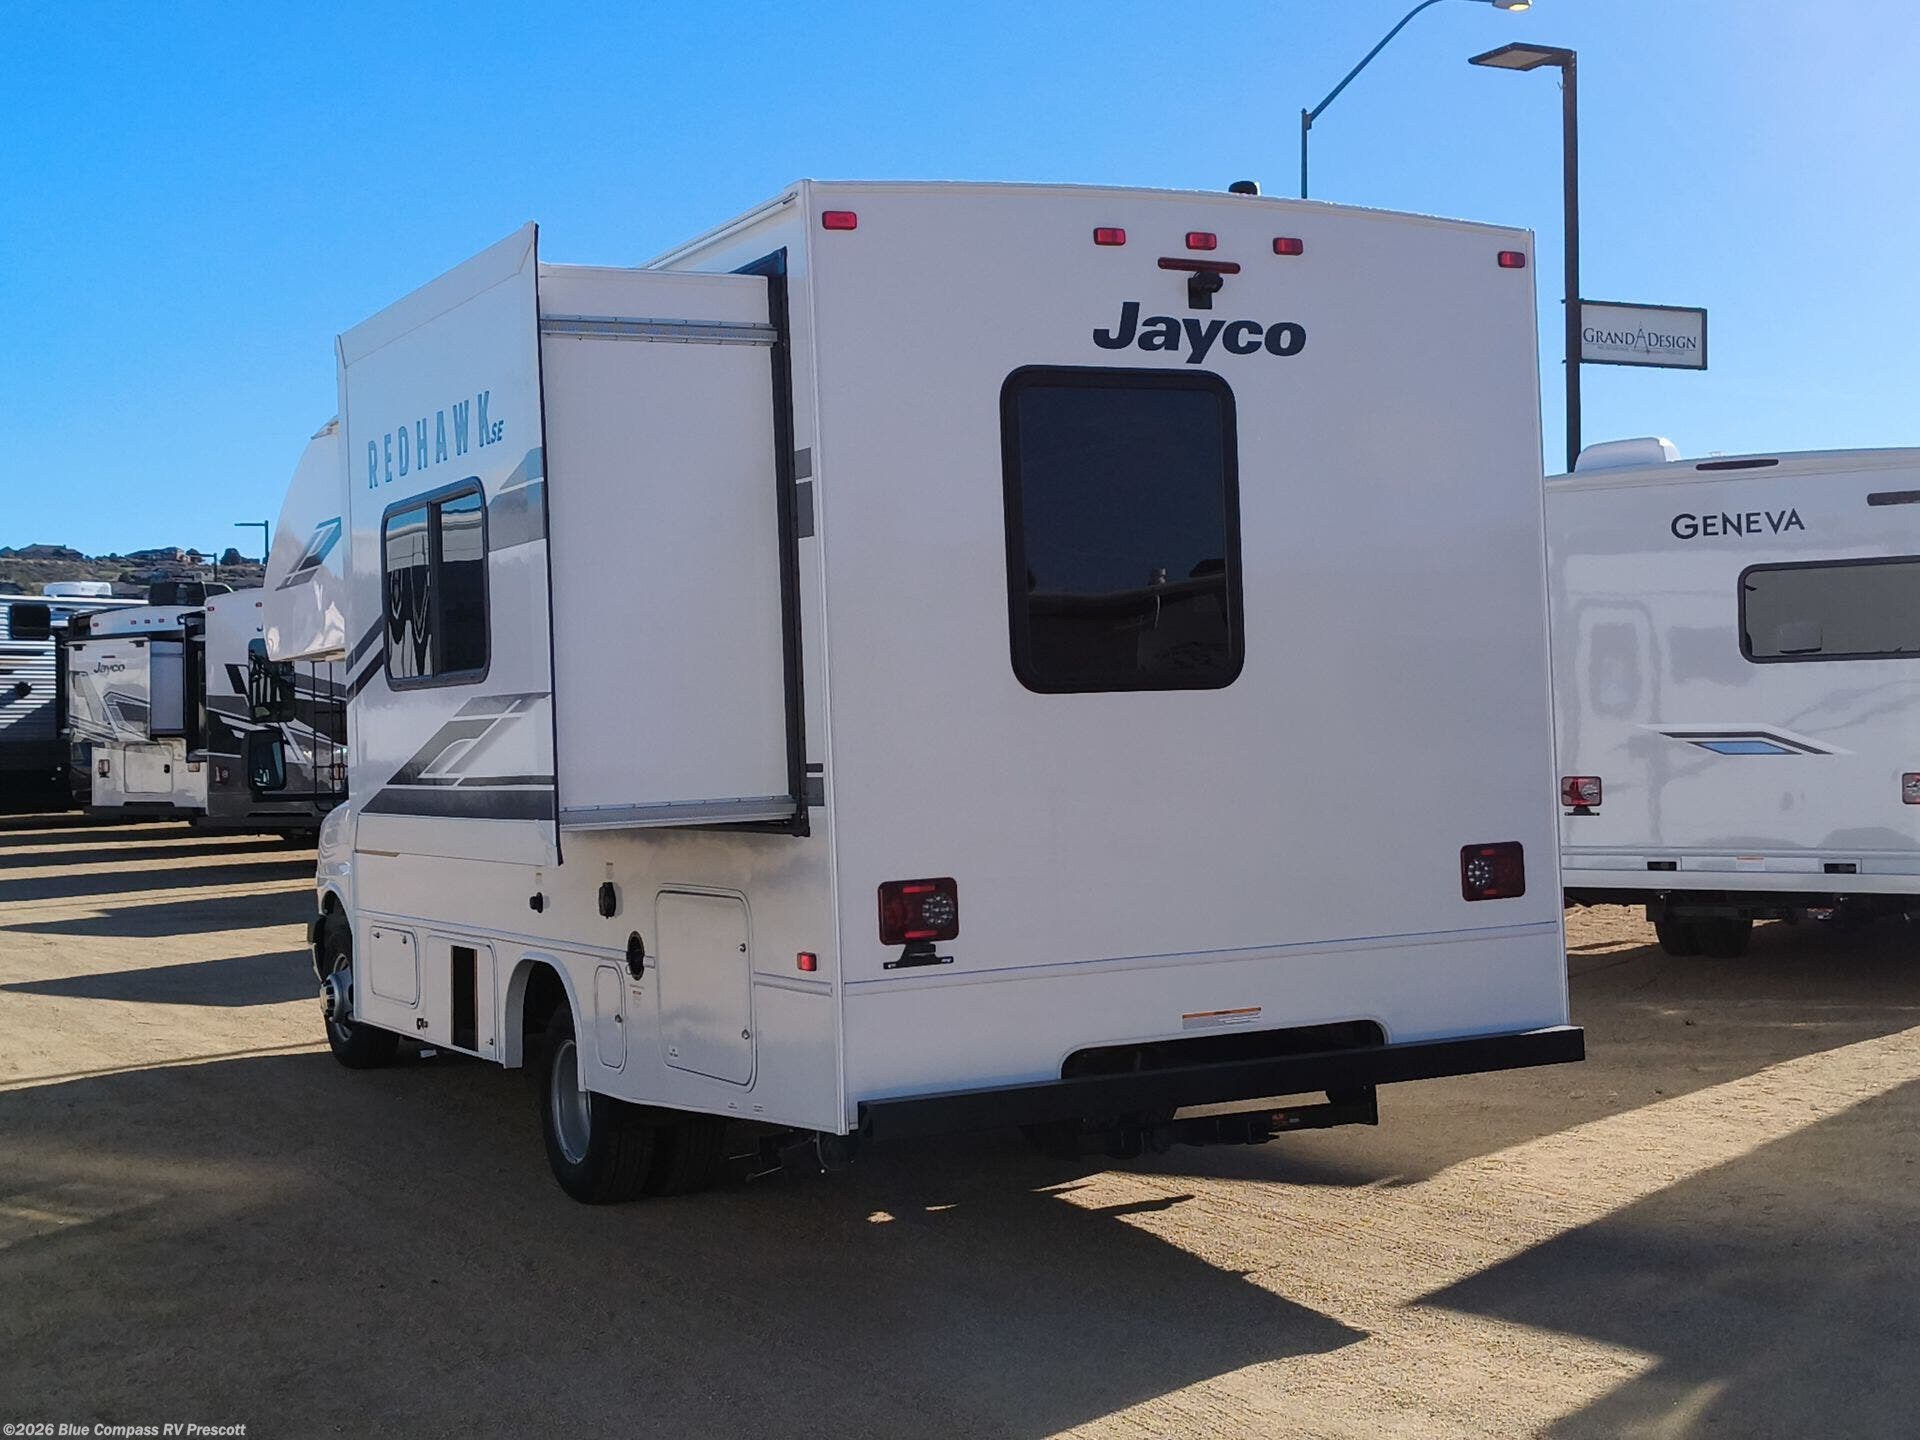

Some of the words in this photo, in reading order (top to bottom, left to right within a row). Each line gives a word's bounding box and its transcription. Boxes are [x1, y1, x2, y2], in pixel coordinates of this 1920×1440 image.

[1092, 301, 1307, 364] Jayco
[1583, 327, 1636, 345] GRAND
[1647, 331, 1697, 349] DESIGN
[368, 390, 491, 489] REDHAWK
[490, 420, 504, 444] SE
[1671, 508, 1805, 540] GENEVA
[93, 661, 126, 675] Jayco
